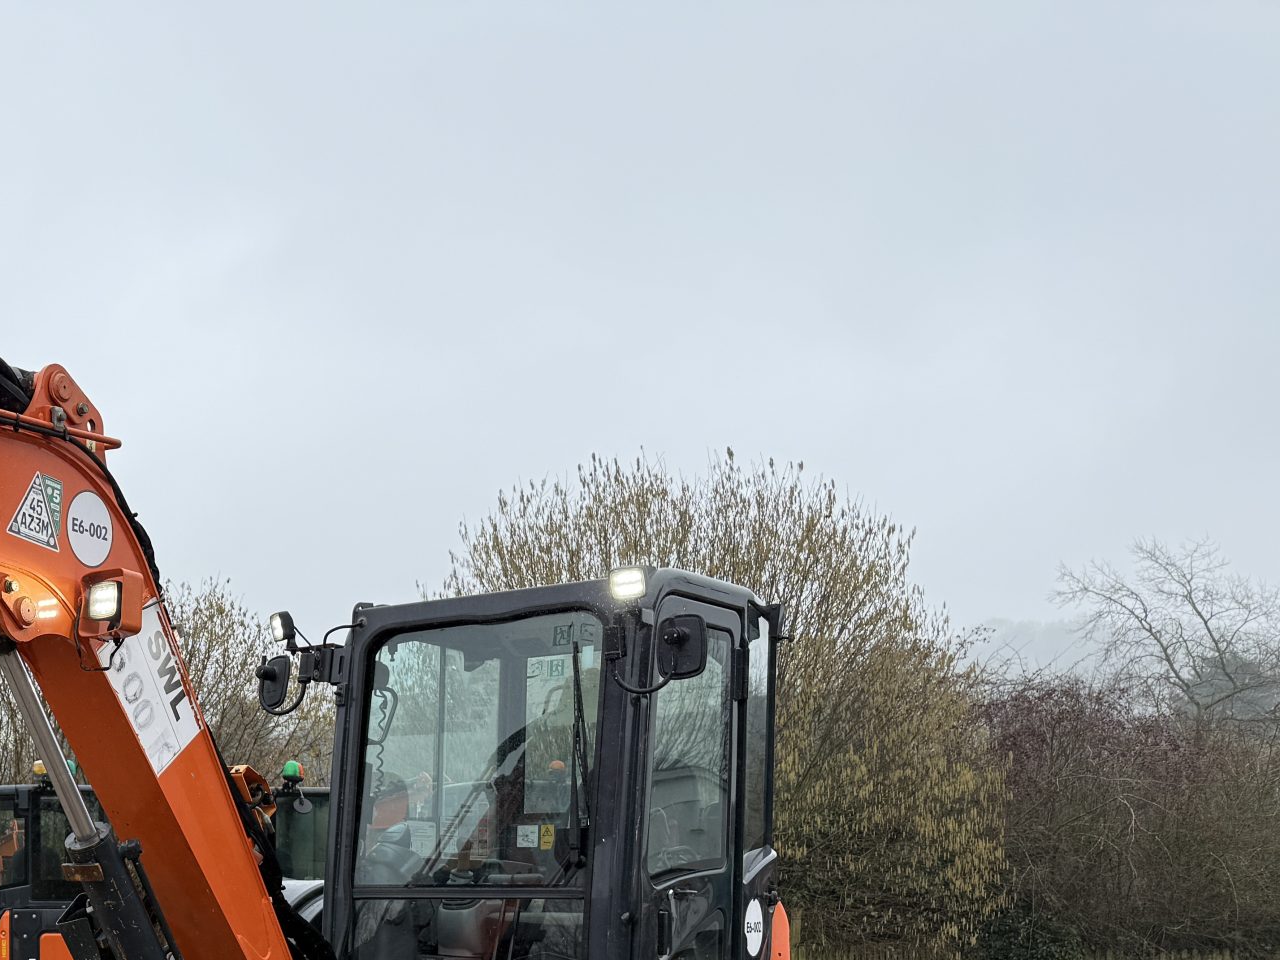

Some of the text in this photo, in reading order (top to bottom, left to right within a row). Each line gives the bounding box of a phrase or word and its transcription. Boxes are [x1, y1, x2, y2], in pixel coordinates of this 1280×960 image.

[29, 497, 43, 517] 45
[52, 489, 61, 504] 5
[20, 511, 50, 538] AZ3M
[71, 516, 108, 542] E6-002
[147, 630, 187, 722] SWL
